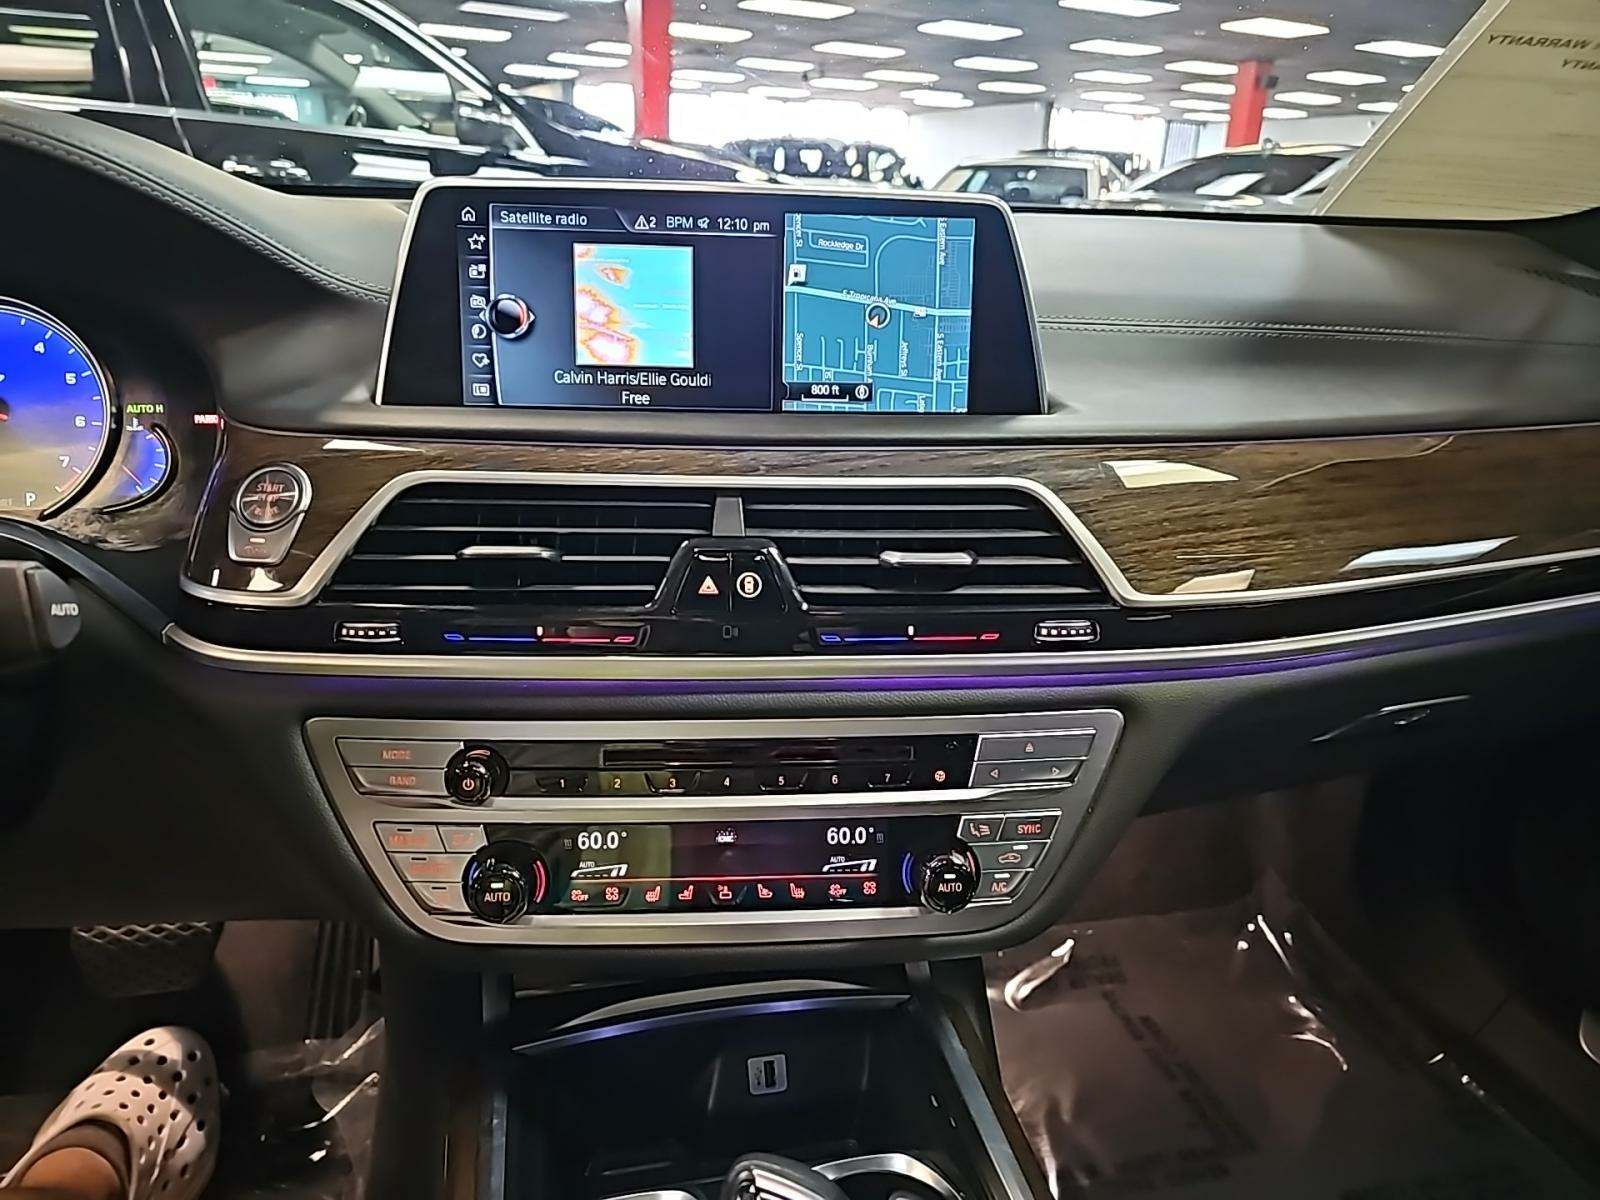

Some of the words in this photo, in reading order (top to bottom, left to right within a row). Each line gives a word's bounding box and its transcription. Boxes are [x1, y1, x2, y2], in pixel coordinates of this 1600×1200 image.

[500, 210, 552, 224] Satellite
[555, 213, 588, 226] radio
[649, 216, 657, 228] 2
[666, 216, 693, 228] BPM
[717, 217, 748, 231] 12:10
[753, 221, 770, 233] pm
[855, 242, 865, 251] Dr
[33, 341, 46, 354] 4
[65, 372, 77, 385] 5
[554, 370, 593, 384] Calvin
[597, 371, 667, 386] Harris/Ellie
[810, 384, 830, 395] 800
[831, 384, 840, 395] ft
[621, 391, 650, 404] Free
[126, 404, 154, 413] AUTO
[74, 415, 87, 428] 6
[58, 455, 70, 468] 7
[256, 483, 285, 492] START
[25, 492, 36, 507] P
[50, 603, 79, 616] AUTO
[559, 778, 565, 788] 1
[613, 778, 621, 789] 2
[669, 778, 676, 788] 3
[723, 776, 730, 787] 4
[778, 775, 785, 786] 5
[831, 774, 838, 785] 6
[885, 773, 891, 783] 7
[1017, 823, 1042, 834] SYNC
[937, 882, 963, 893] AUTO
[991, 882, 1008, 892] A/C
[483, 891, 511, 903] AUTO
